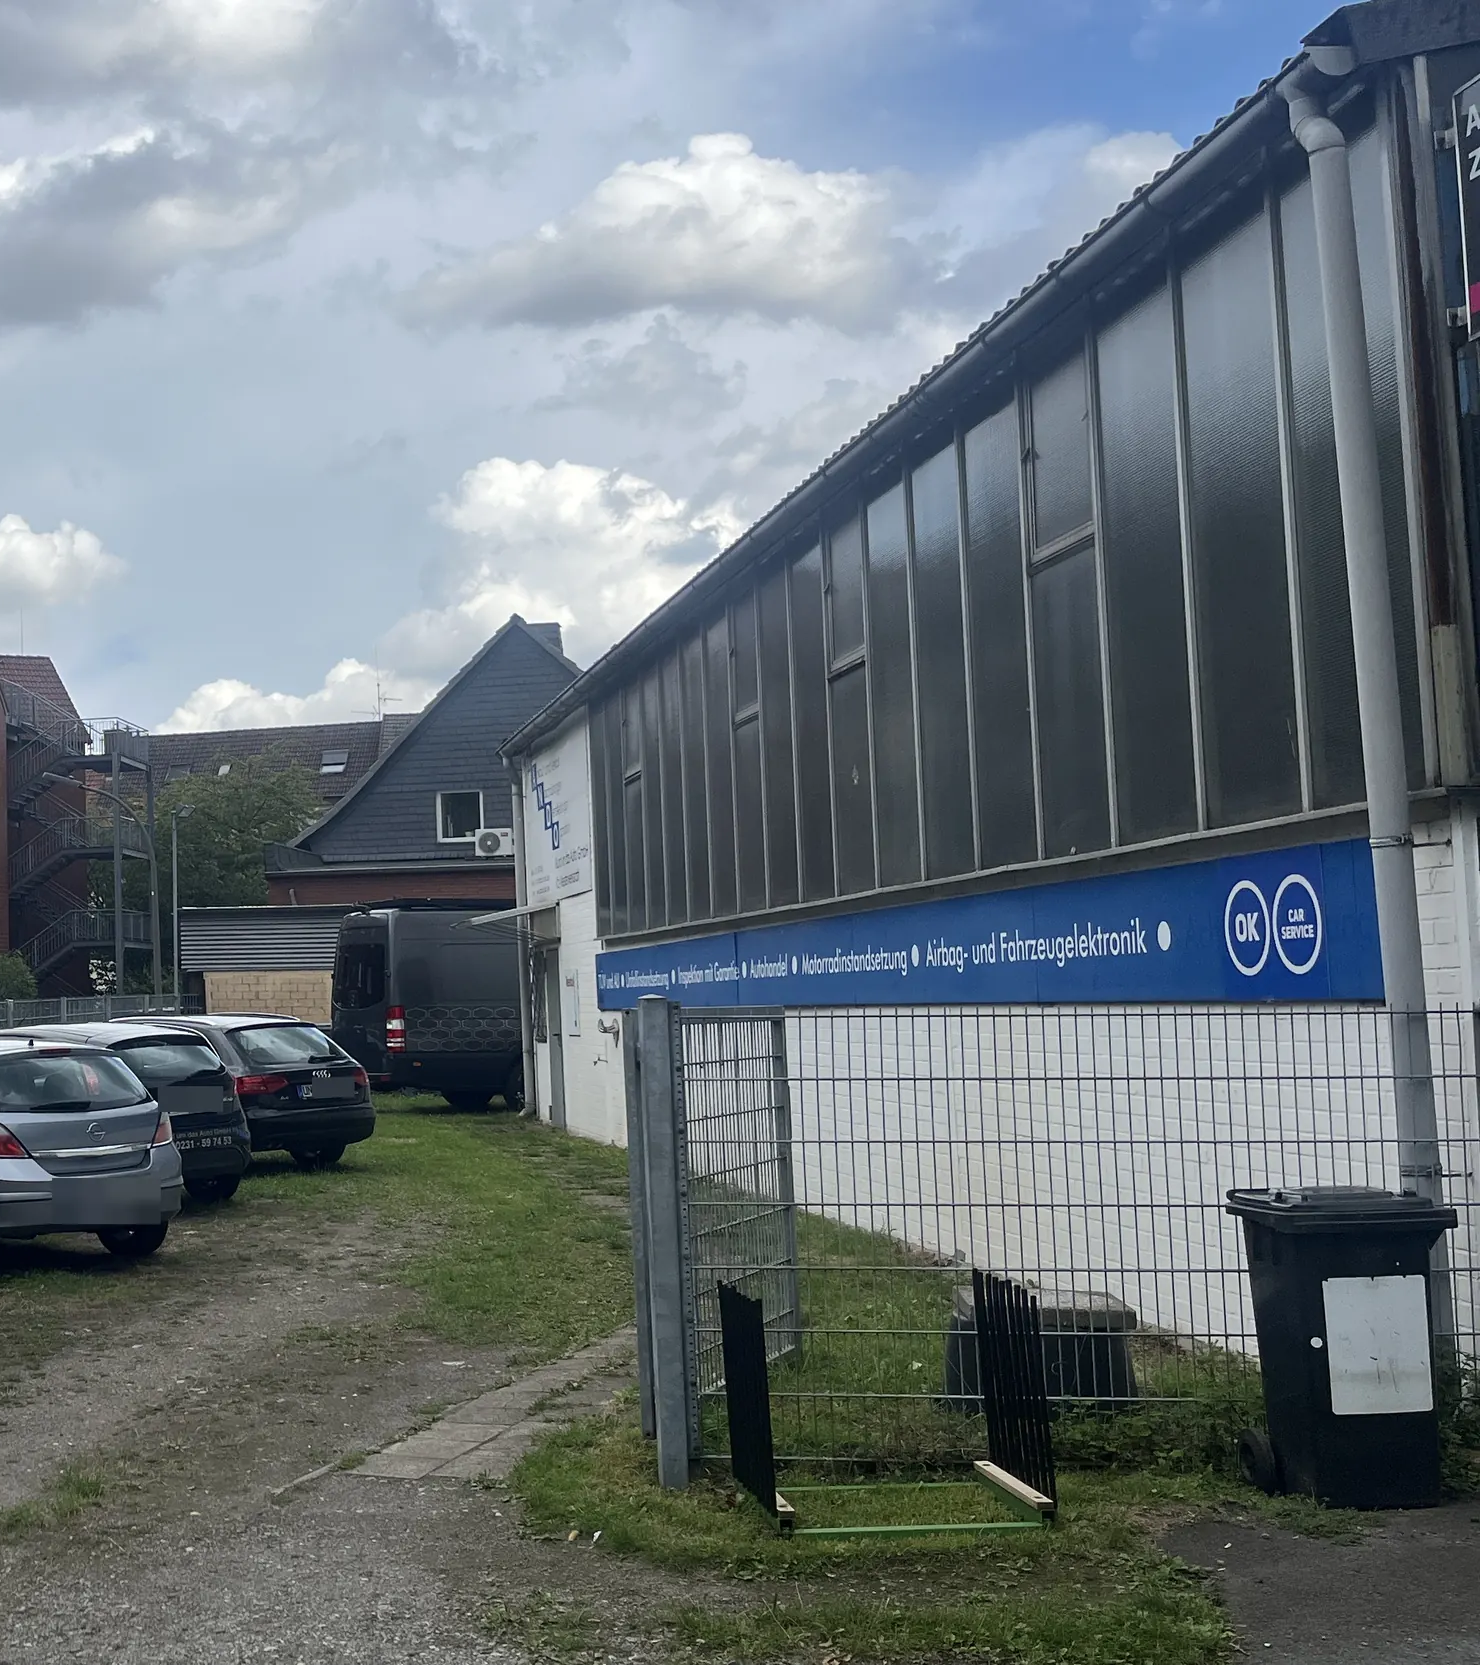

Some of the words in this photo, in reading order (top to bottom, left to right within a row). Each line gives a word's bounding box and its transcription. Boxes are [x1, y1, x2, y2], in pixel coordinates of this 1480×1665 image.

[1234, 912, 1260, 943] OK
[1288, 908, 1305, 923] CAR
[926, 936, 969, 973] Airbag-
[972, 932, 996, 965] und
[1000, 917, 1148, 968] Fahrzeugelektronik
[1280, 924, 1315, 940] SERVICE
[678, 964, 704, 989] Inspektion
[704, 962, 714, 983] mit
[714, 960, 740, 982] Garantie
[750, 952, 788, 979] Autohandel
[802, 944, 908, 977] Motorradinstandsetzung
[175, 1140, 195, 1150] 0231
[201, 1138, 211, 1148] 59
[212, 1136, 222, 1146] 74
[223, 1136, 232, 1146] 53
